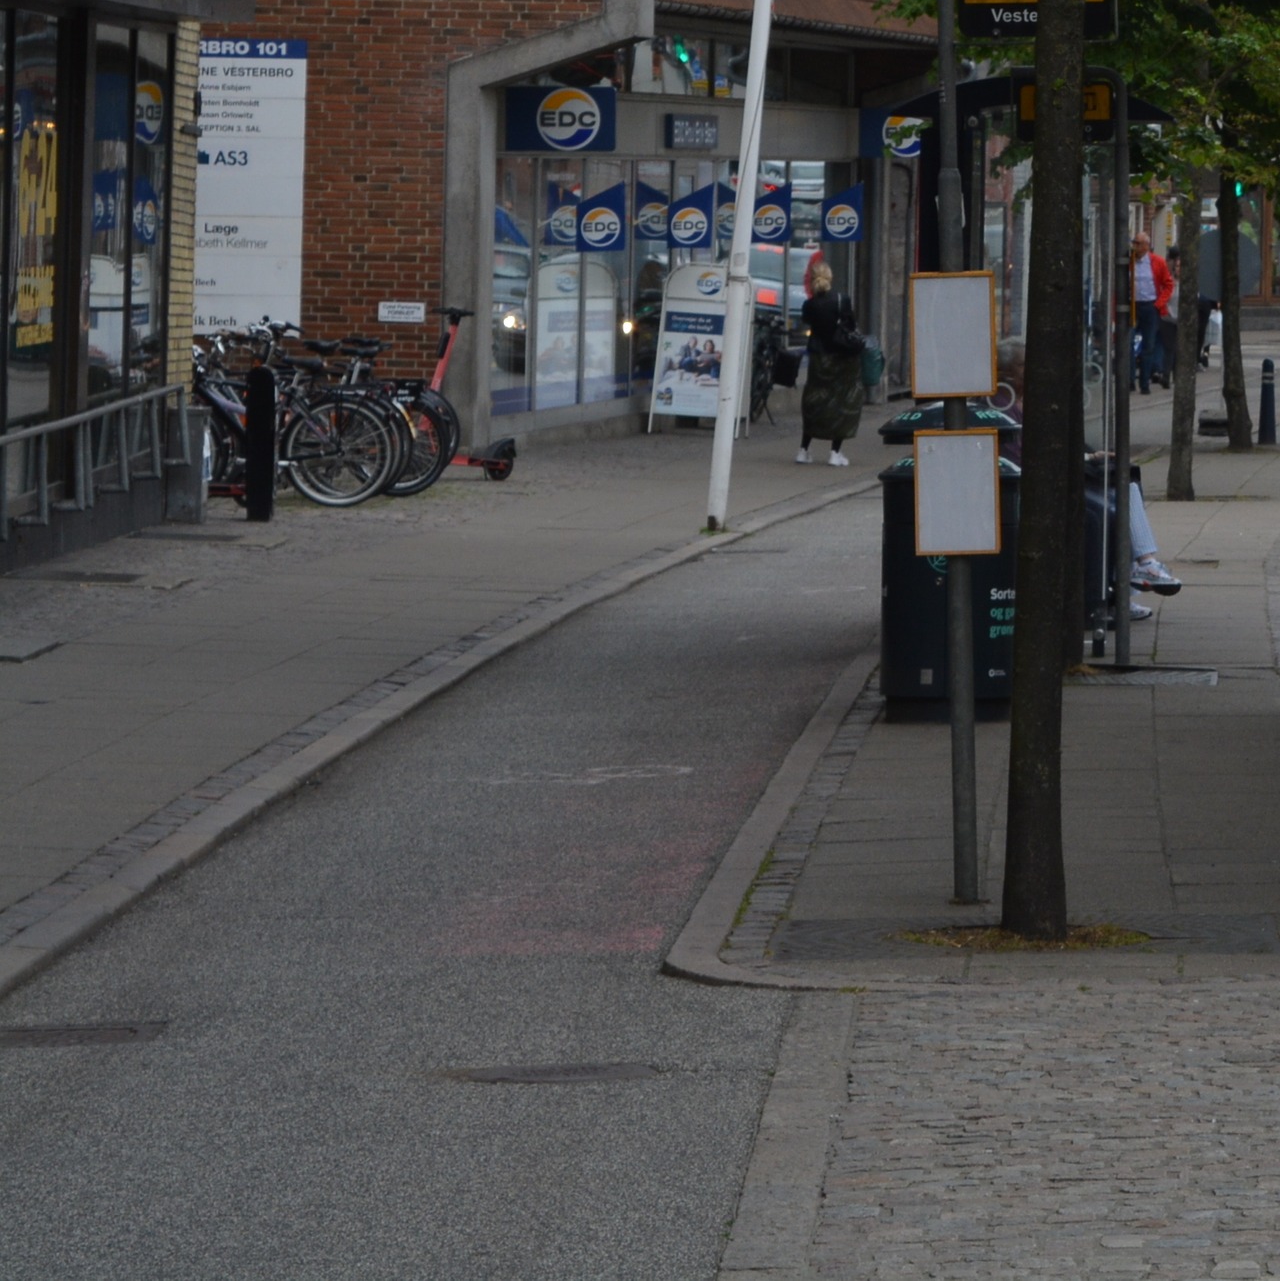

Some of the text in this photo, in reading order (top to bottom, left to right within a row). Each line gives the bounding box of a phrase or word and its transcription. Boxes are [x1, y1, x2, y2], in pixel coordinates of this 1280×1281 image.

[256, 42, 288, 56] 101
[222, 67, 294, 78] VESTERBRO
[539, 110, 597, 128] EDC
[213, 150, 248, 167] AS3
[672, 220, 706, 231] EDC
[753, 215, 785, 226] EDC
[827, 216, 857, 226] EDC
[203, 223, 239, 236] Læge
[582, 221, 618, 233] EDC
[697, 279, 723, 288] EDC
[209, 316, 237, 326] Bech
